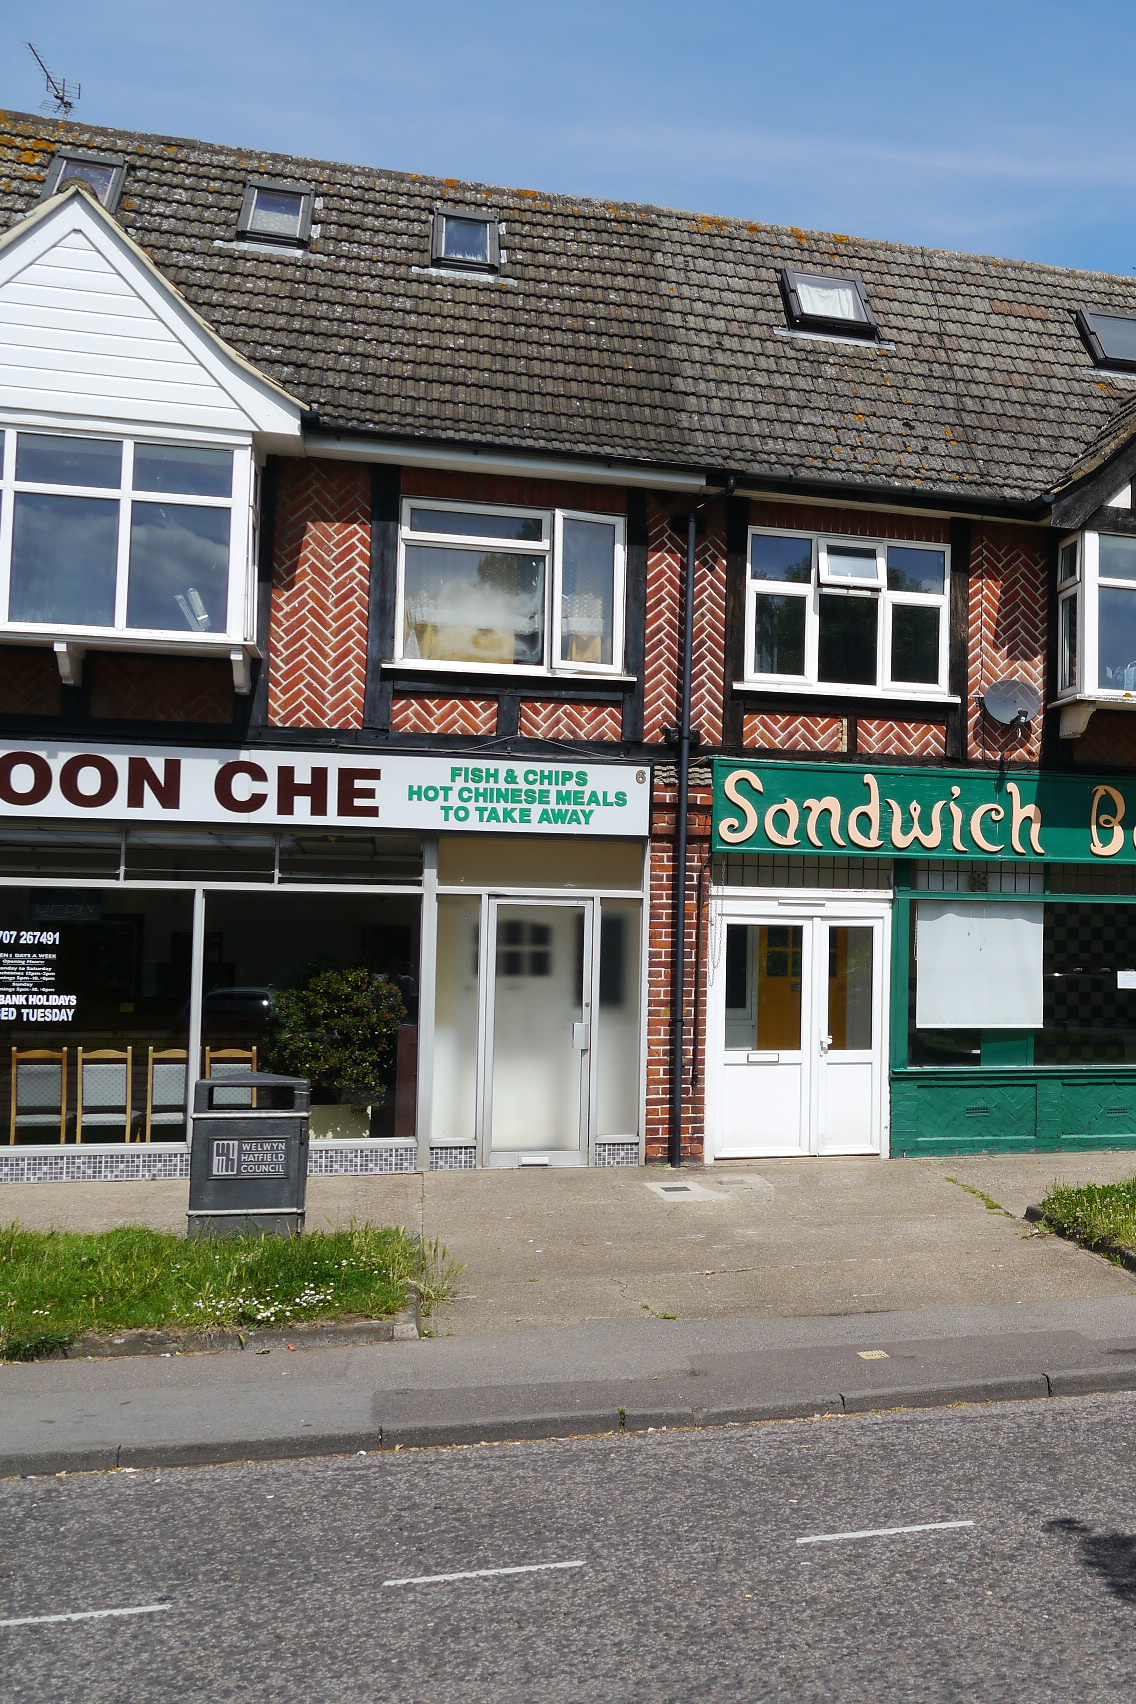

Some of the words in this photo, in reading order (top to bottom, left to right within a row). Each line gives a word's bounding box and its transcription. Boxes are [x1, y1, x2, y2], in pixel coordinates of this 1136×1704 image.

[451, 766, 499, 784] FISH
[504, 768, 518, 784] &
[523, 769, 588, 786] CHIPS
[635, 770, 646, 784] 6
[0, 751, 181, 810] OON
[214, 760, 382, 818] CHE
[408, 785, 453, 802] HOT
[457, 786, 551, 805] CHINESE
[555, 790, 628, 807] MEALS
[440, 805, 470, 822] TO
[475, 806, 531, 823] TAKE
[537, 808, 595, 825] AWAY
[718, 769, 1045, 854] Sandwich
[19, 931, 60, 945] 267491
[29, 995, 77, 1006] HOLIDAYS
[21, 1008, 75, 1021] TUESDAY
[242, 1142, 286, 1151] WELWYN
[241, 1153, 285, 1162] HATFIELD
[240, 1164, 284, 1173] COUNCIL
